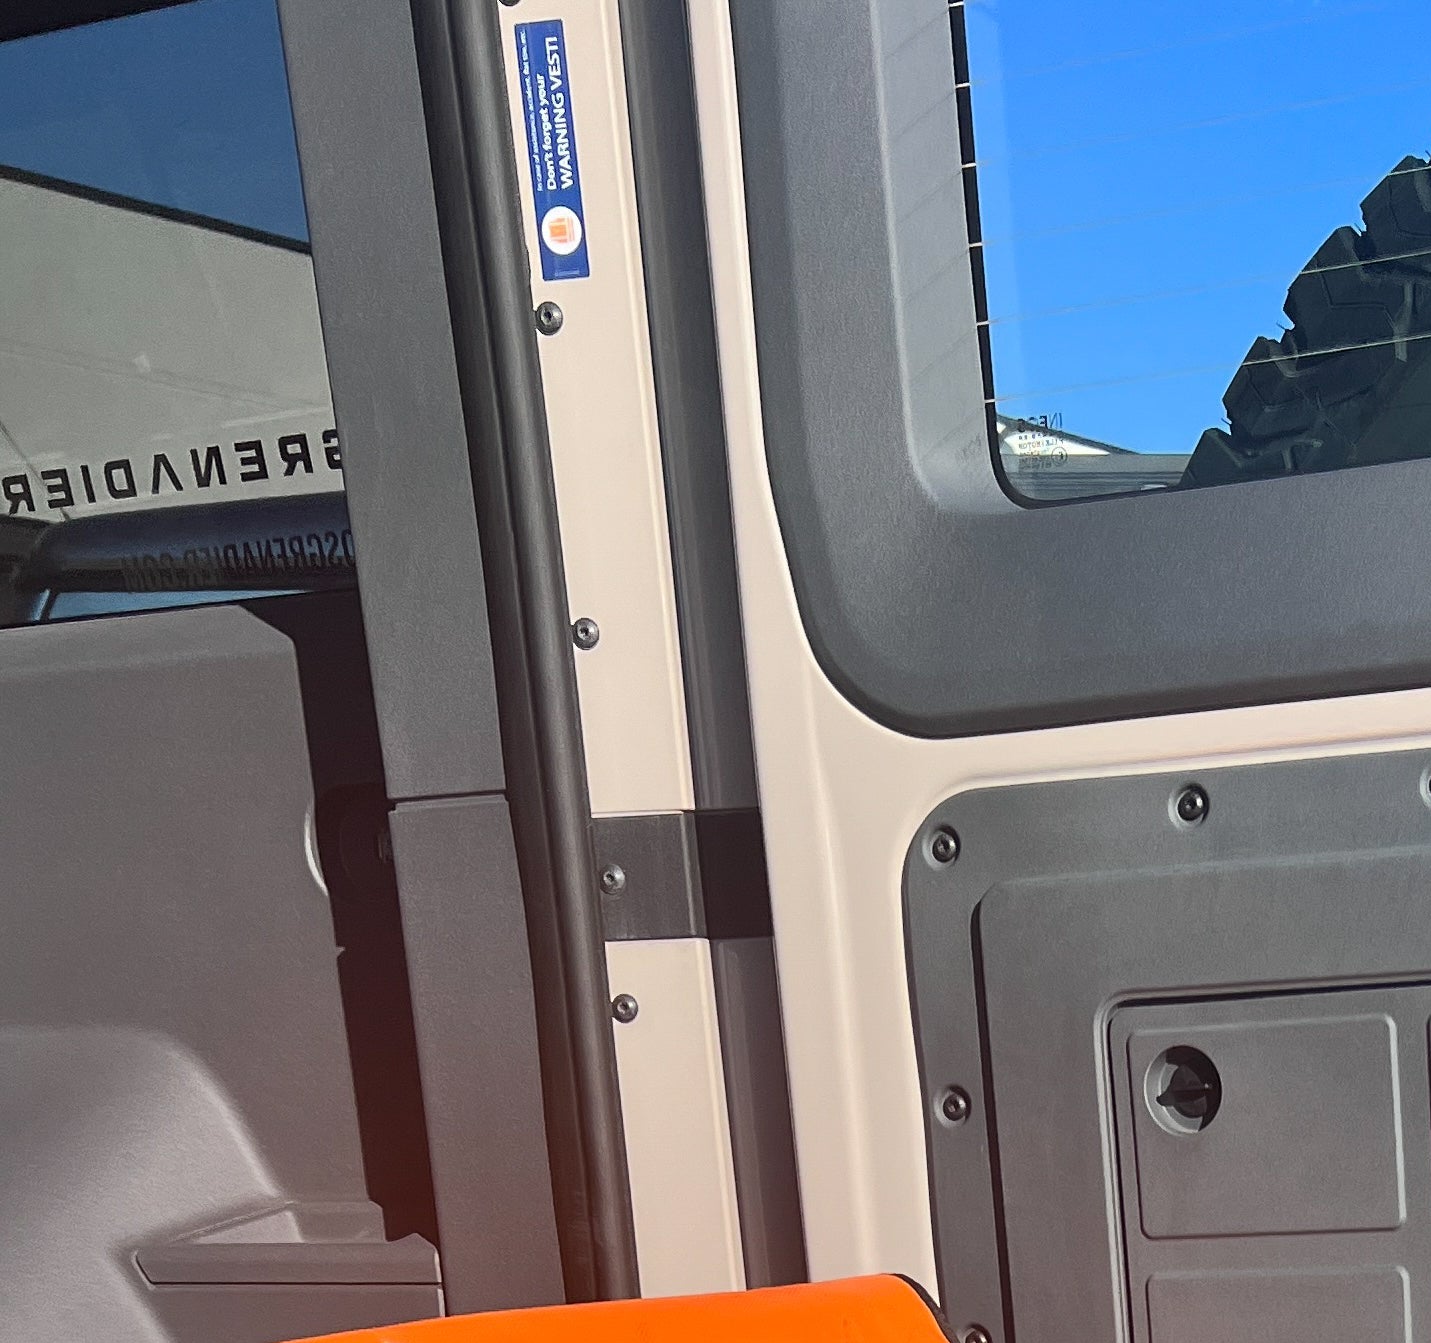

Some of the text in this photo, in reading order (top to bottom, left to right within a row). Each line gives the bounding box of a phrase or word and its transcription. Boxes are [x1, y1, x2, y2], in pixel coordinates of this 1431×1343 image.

[536, 74, 557, 190] Don't forget your
[551, 92, 574, 190] WARNING
